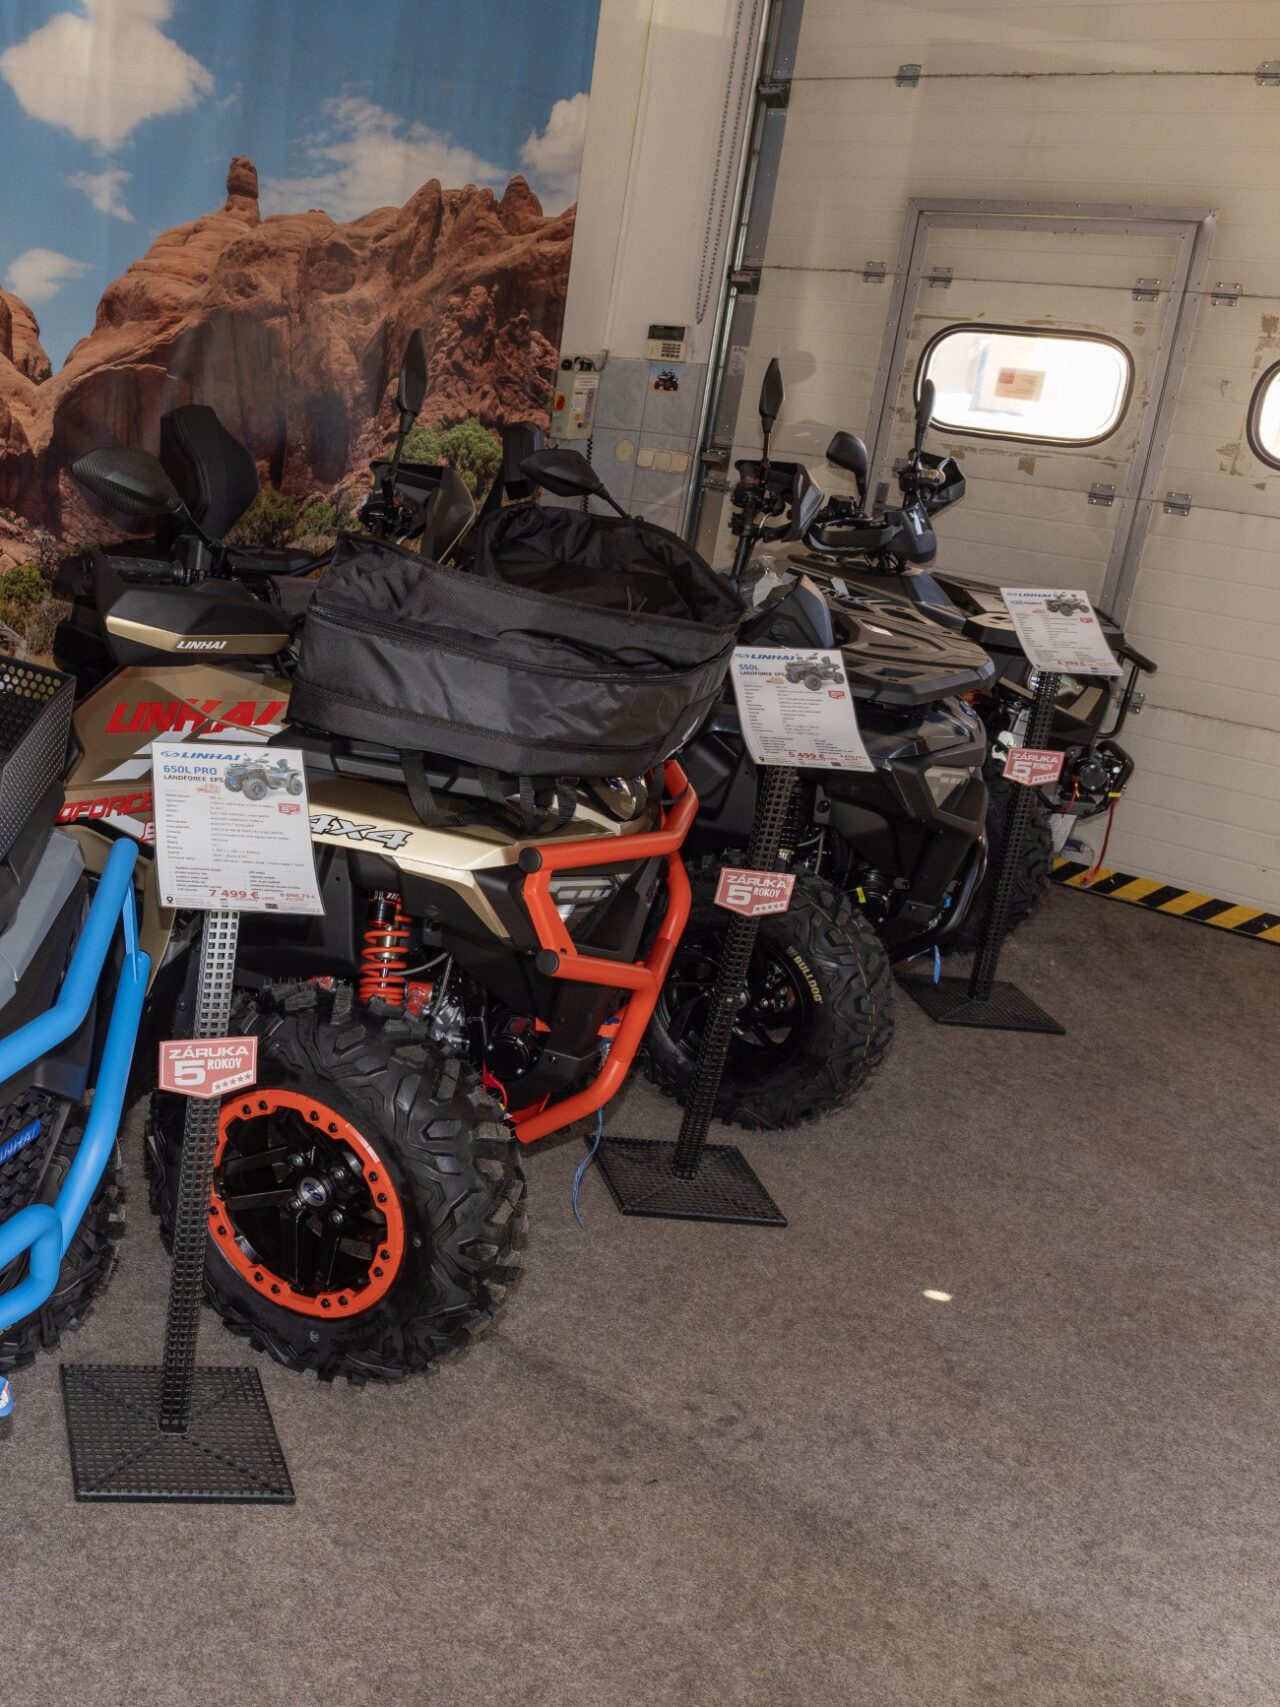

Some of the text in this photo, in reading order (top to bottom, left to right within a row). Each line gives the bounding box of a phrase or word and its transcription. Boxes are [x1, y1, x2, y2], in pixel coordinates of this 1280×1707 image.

[176, 641, 227, 650] LINHAI
[104, 698, 288, 735] LINHAI
[181, 752, 241, 761] LINHAI
[1012, 752, 1058, 763] ZÁRUKA
[163, 765, 218, 776] 650L PRO
[1012, 760, 1032, 777] 5
[726, 874, 787, 889] ZÁRUKA
[209, 889, 260, 900] 7 499 €
[726, 884, 781, 906] 5 ROKOV
[793, 956, 822, 1002] BULLDOG
[169, 1046, 249, 1060] ZÁRUKA
[174, 1058, 242, 1086] 5 ROKOV
